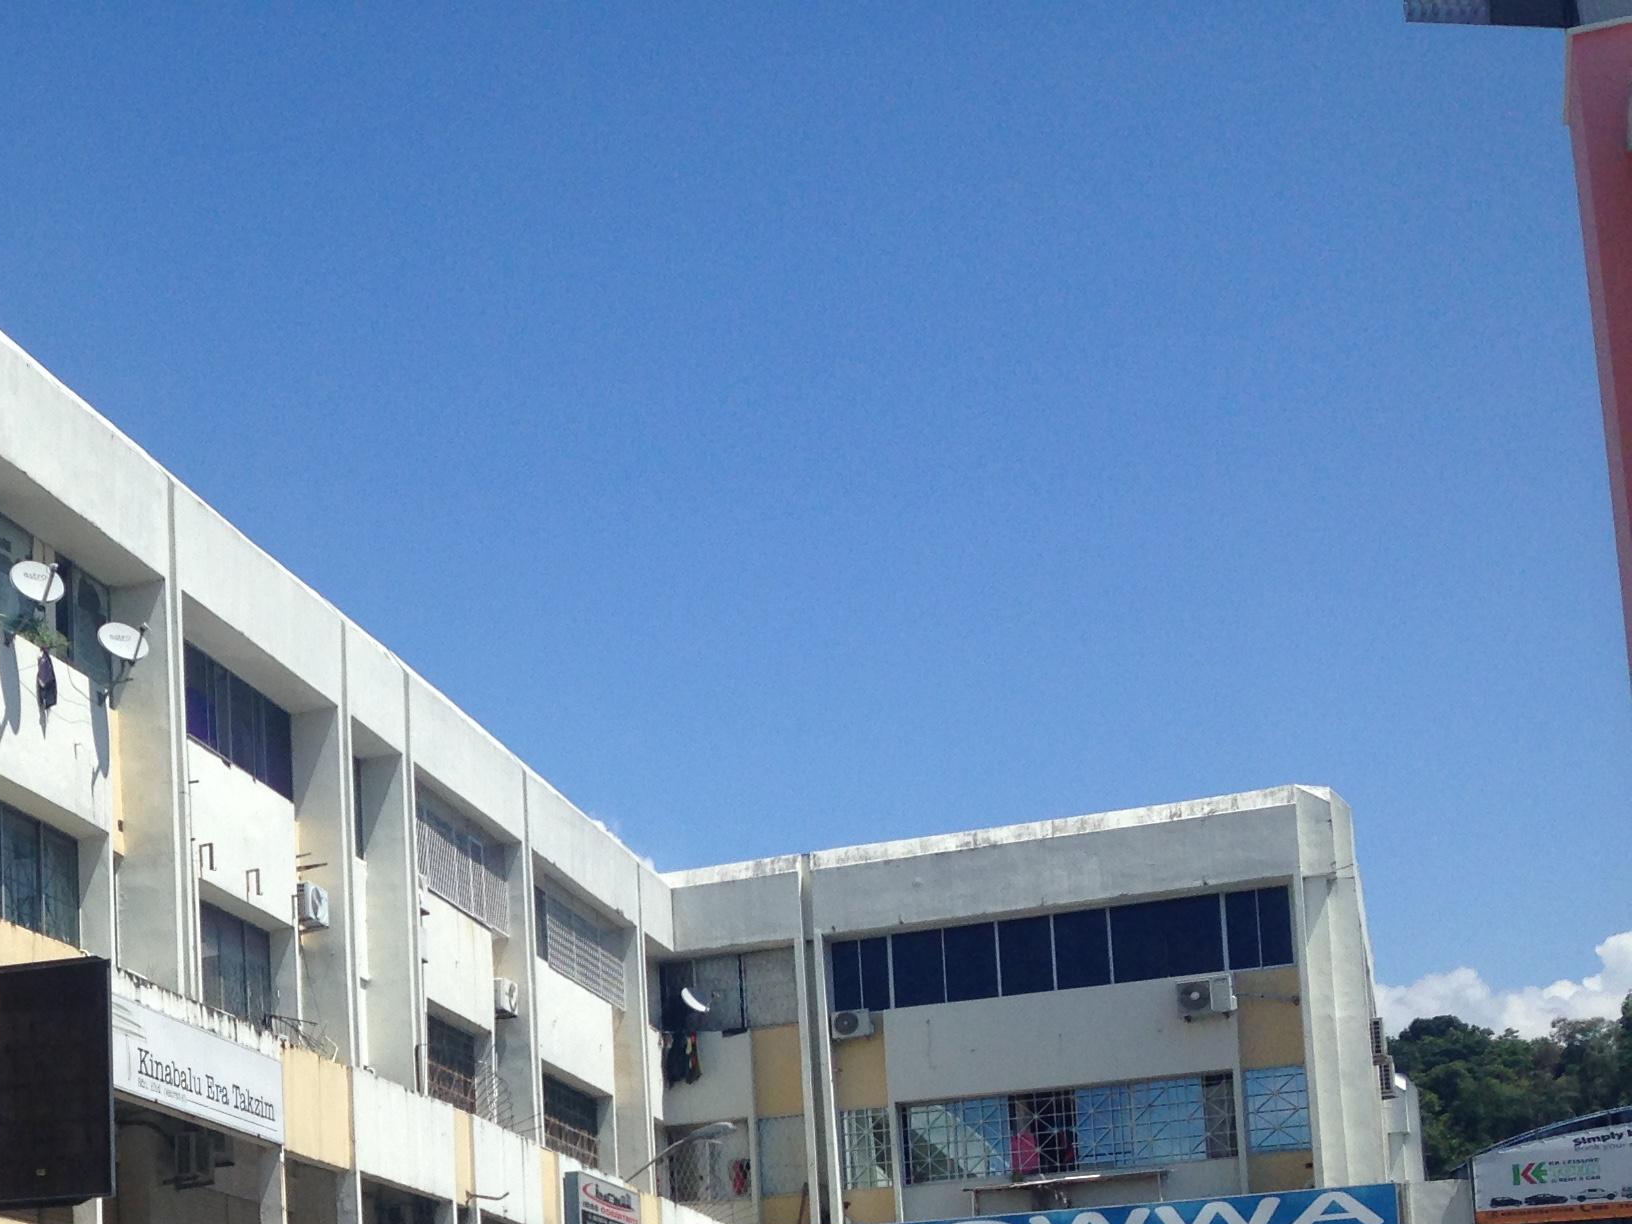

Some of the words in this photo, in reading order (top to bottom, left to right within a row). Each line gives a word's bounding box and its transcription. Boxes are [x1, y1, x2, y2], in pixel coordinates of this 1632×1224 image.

[137, 1047, 202, 1096] Kinabalu
[205, 1074, 229, 1106] Era
[232, 1084, 276, 1122] Takzim
[1572, 1130, 1623, 1146] Simply
